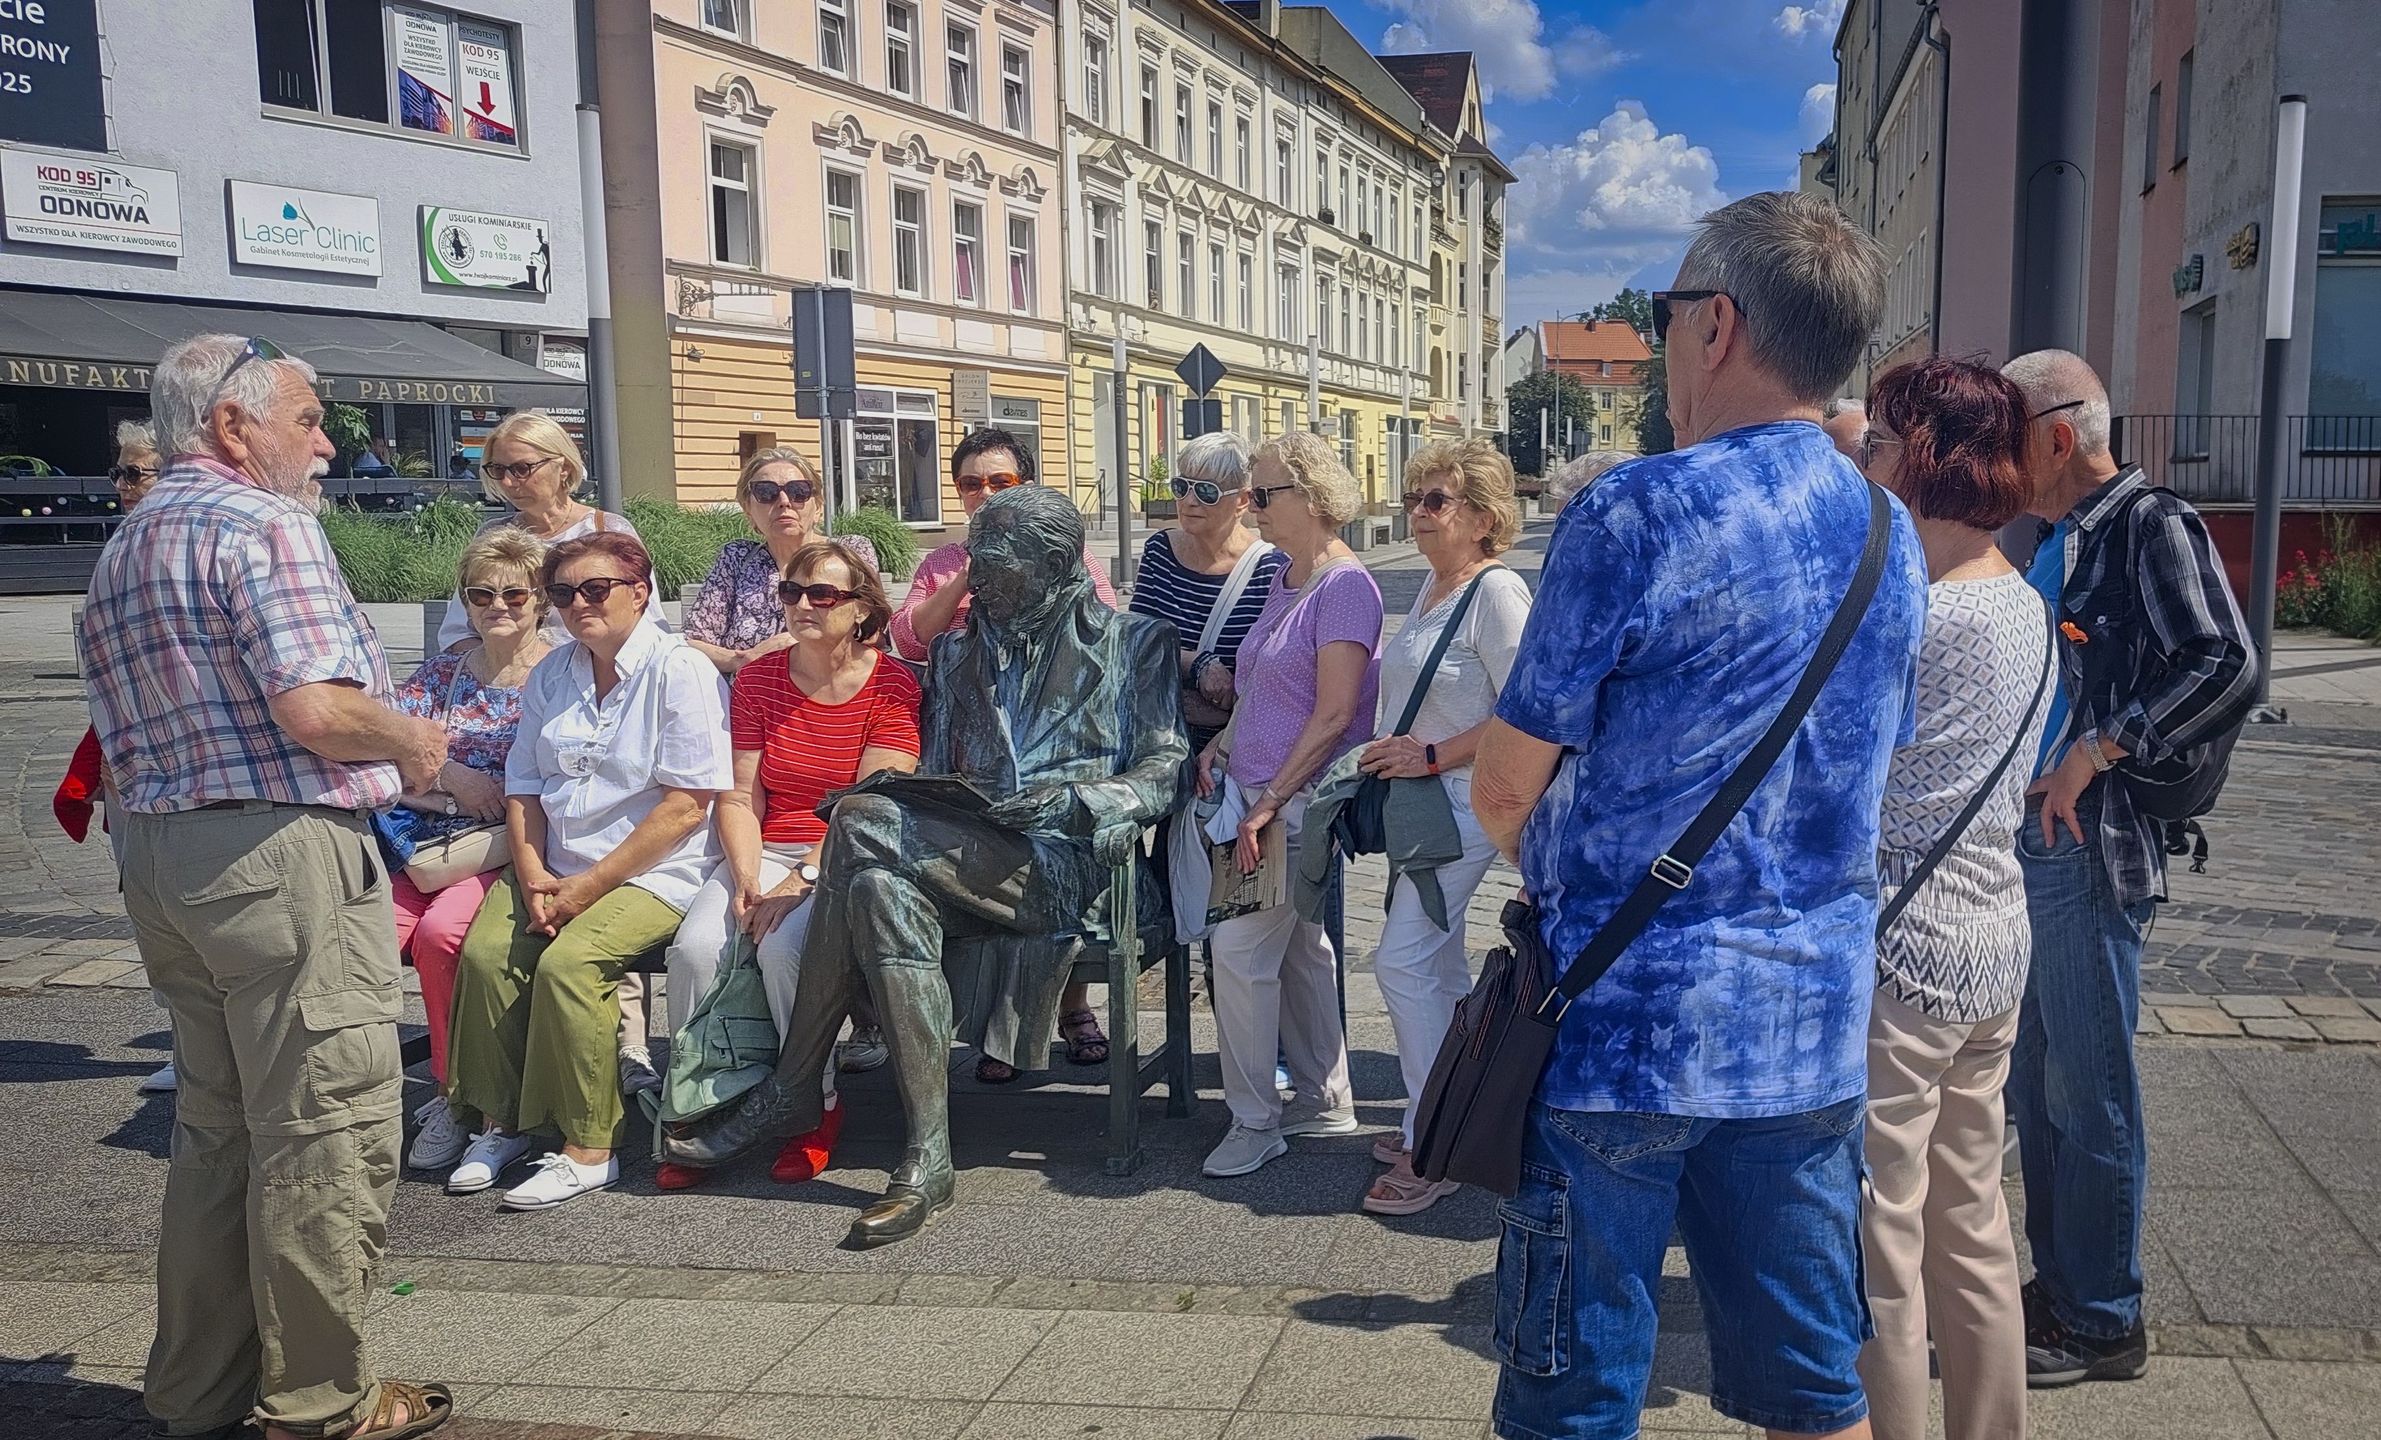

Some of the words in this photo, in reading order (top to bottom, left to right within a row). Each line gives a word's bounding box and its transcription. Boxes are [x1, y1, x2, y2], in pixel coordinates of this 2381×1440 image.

[406, 20, 437, 33] ODNOWA
[460, 26, 500, 40] PSYCHOTESTY
[403, 40, 414, 48] DLA
[415, 43, 442, 53] KIEROWCY
[407, 34, 436, 45] WSZYSTKO
[0, 33, 70, 65] RONY
[403, 47, 443, 61] ZAWODOWEGO
[462, 43, 485, 57] KOD
[487, 49, 500, 61] 95
[466, 65, 500, 80] WEJŚCIE
[0, 71, 32, 94] 25
[36, 165, 71, 183] KOD
[76, 170, 97, 186] 95
[40, 195, 150, 225] ODNOWA
[478, 216, 532, 231] KOMINIARSKIE
[16, 224, 60, 237] WSZYSTKO
[61, 230, 78, 239] DLA
[80, 231, 120, 244] KIEROWCY
[121, 236, 177, 249] ZAWODOWEGO
[242, 217, 310, 246] Laser
[316, 226, 375, 254] Clinic
[250, 245, 280, 257] Gabinet
[281, 248, 330, 262] Kosmetologii
[330, 253, 370, 266] Estetycznej
[480, 251, 493, 259] 570
[525, 336, 531, 346] 9
[543, 359, 581, 370] ODNOWA
[358, 380, 495, 403] PAPROCKI
